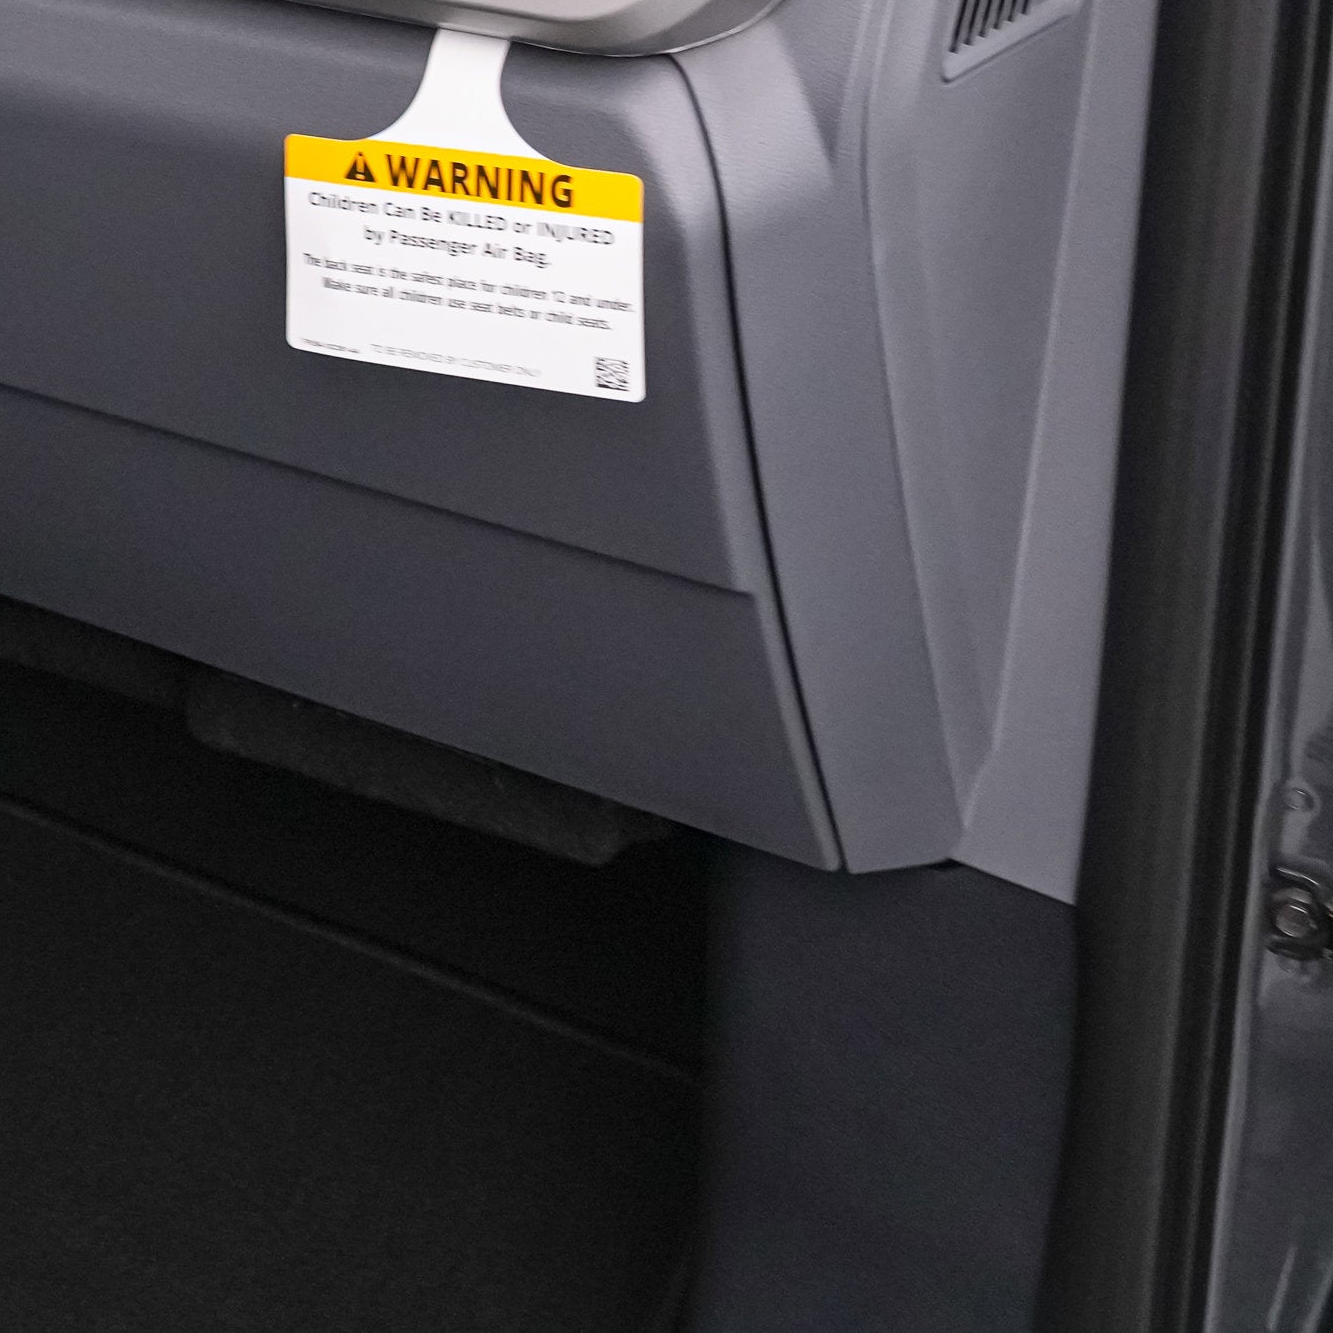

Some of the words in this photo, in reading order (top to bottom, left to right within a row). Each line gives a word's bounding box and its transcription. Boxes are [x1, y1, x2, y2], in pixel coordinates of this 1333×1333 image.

[385, 154, 574, 208] WARNING
[308, 192, 379, 214] Children
[383, 202, 416, 219] Can
[421, 207, 442, 223] Be
[446, 211, 508, 231] KILLED
[513, 222, 531, 234] or
[537, 223, 615, 245] INJURED
[363, 226, 385, 245] by
[389, 229, 477, 257] Passenger
[482, 243, 507, 258] Air
